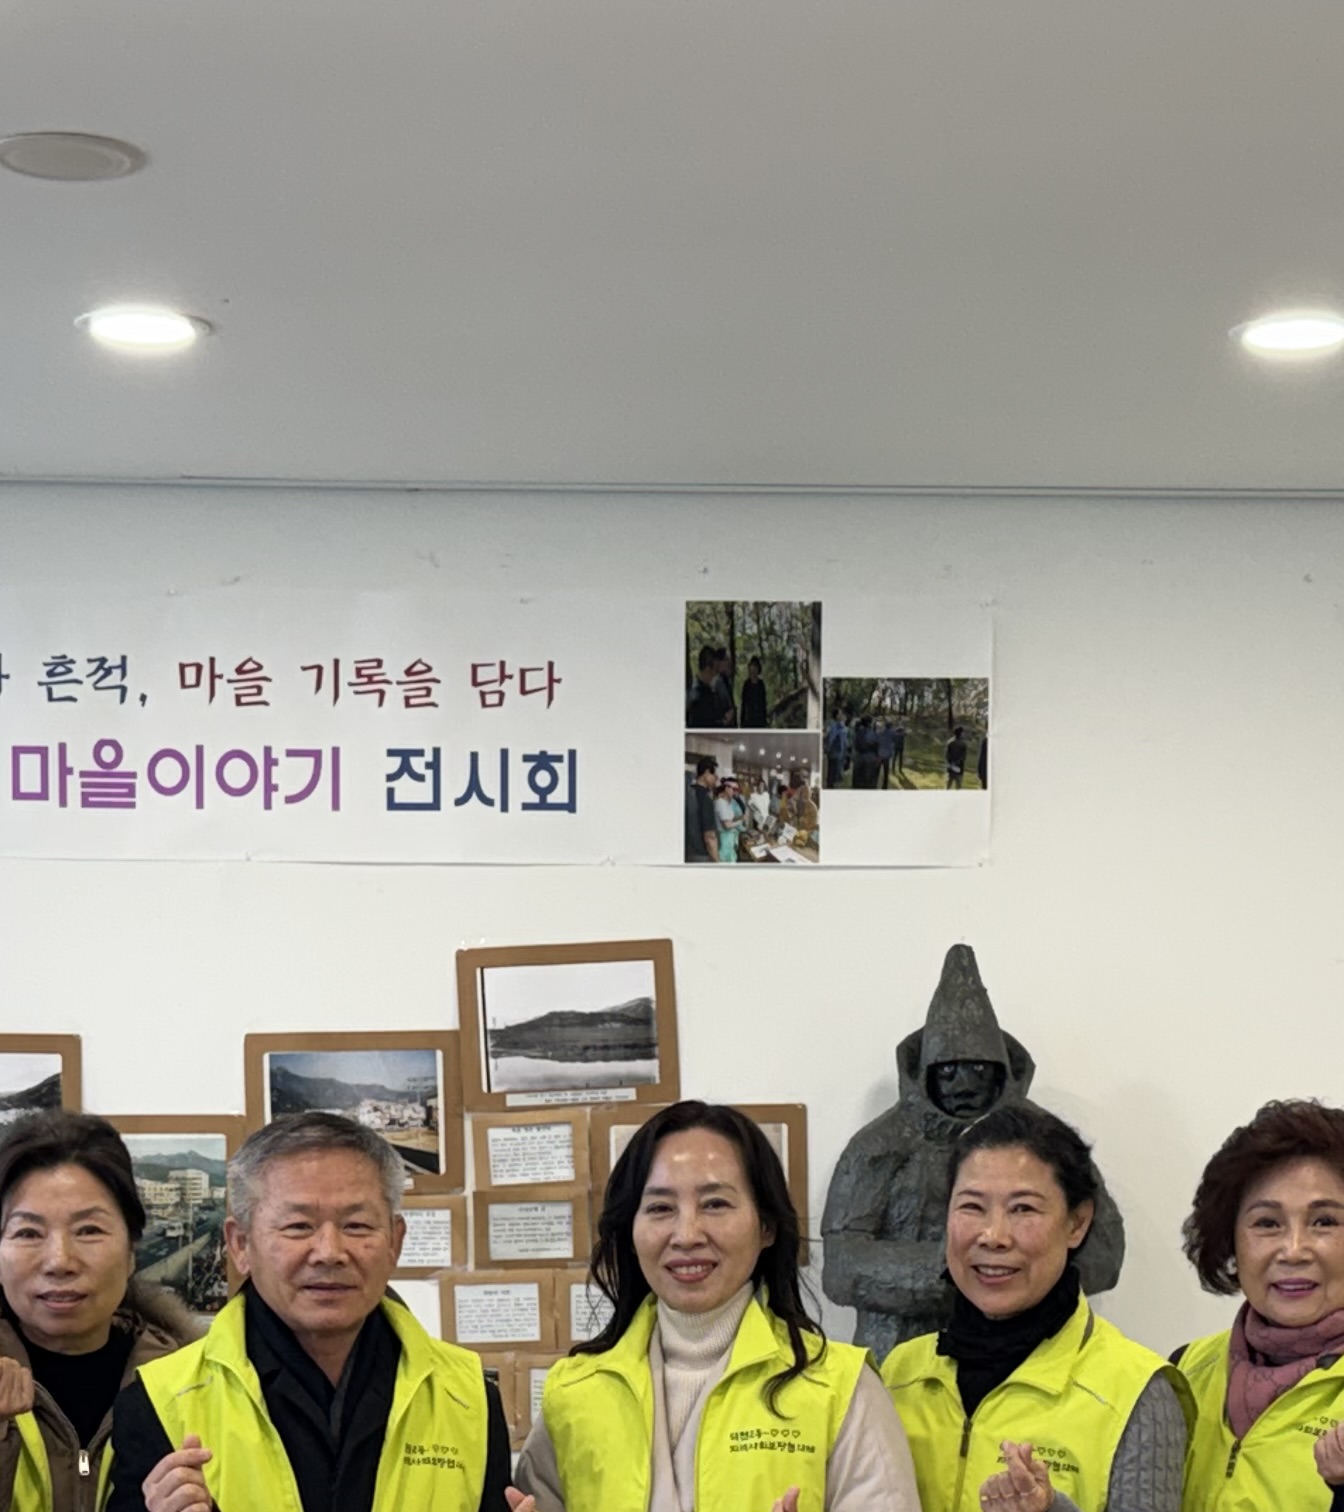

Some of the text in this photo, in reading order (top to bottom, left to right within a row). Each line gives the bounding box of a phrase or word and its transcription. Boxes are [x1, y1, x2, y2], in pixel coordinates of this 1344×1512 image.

[37, 654, 147, 707] 흔적,
[179, 656, 272, 707] 마을
[300, 658, 441, 709] 기록을
[471, 660, 562, 709] 담다
[11, 738, 340, 811] 마을이야기
[386, 746, 577, 814] 전시회
